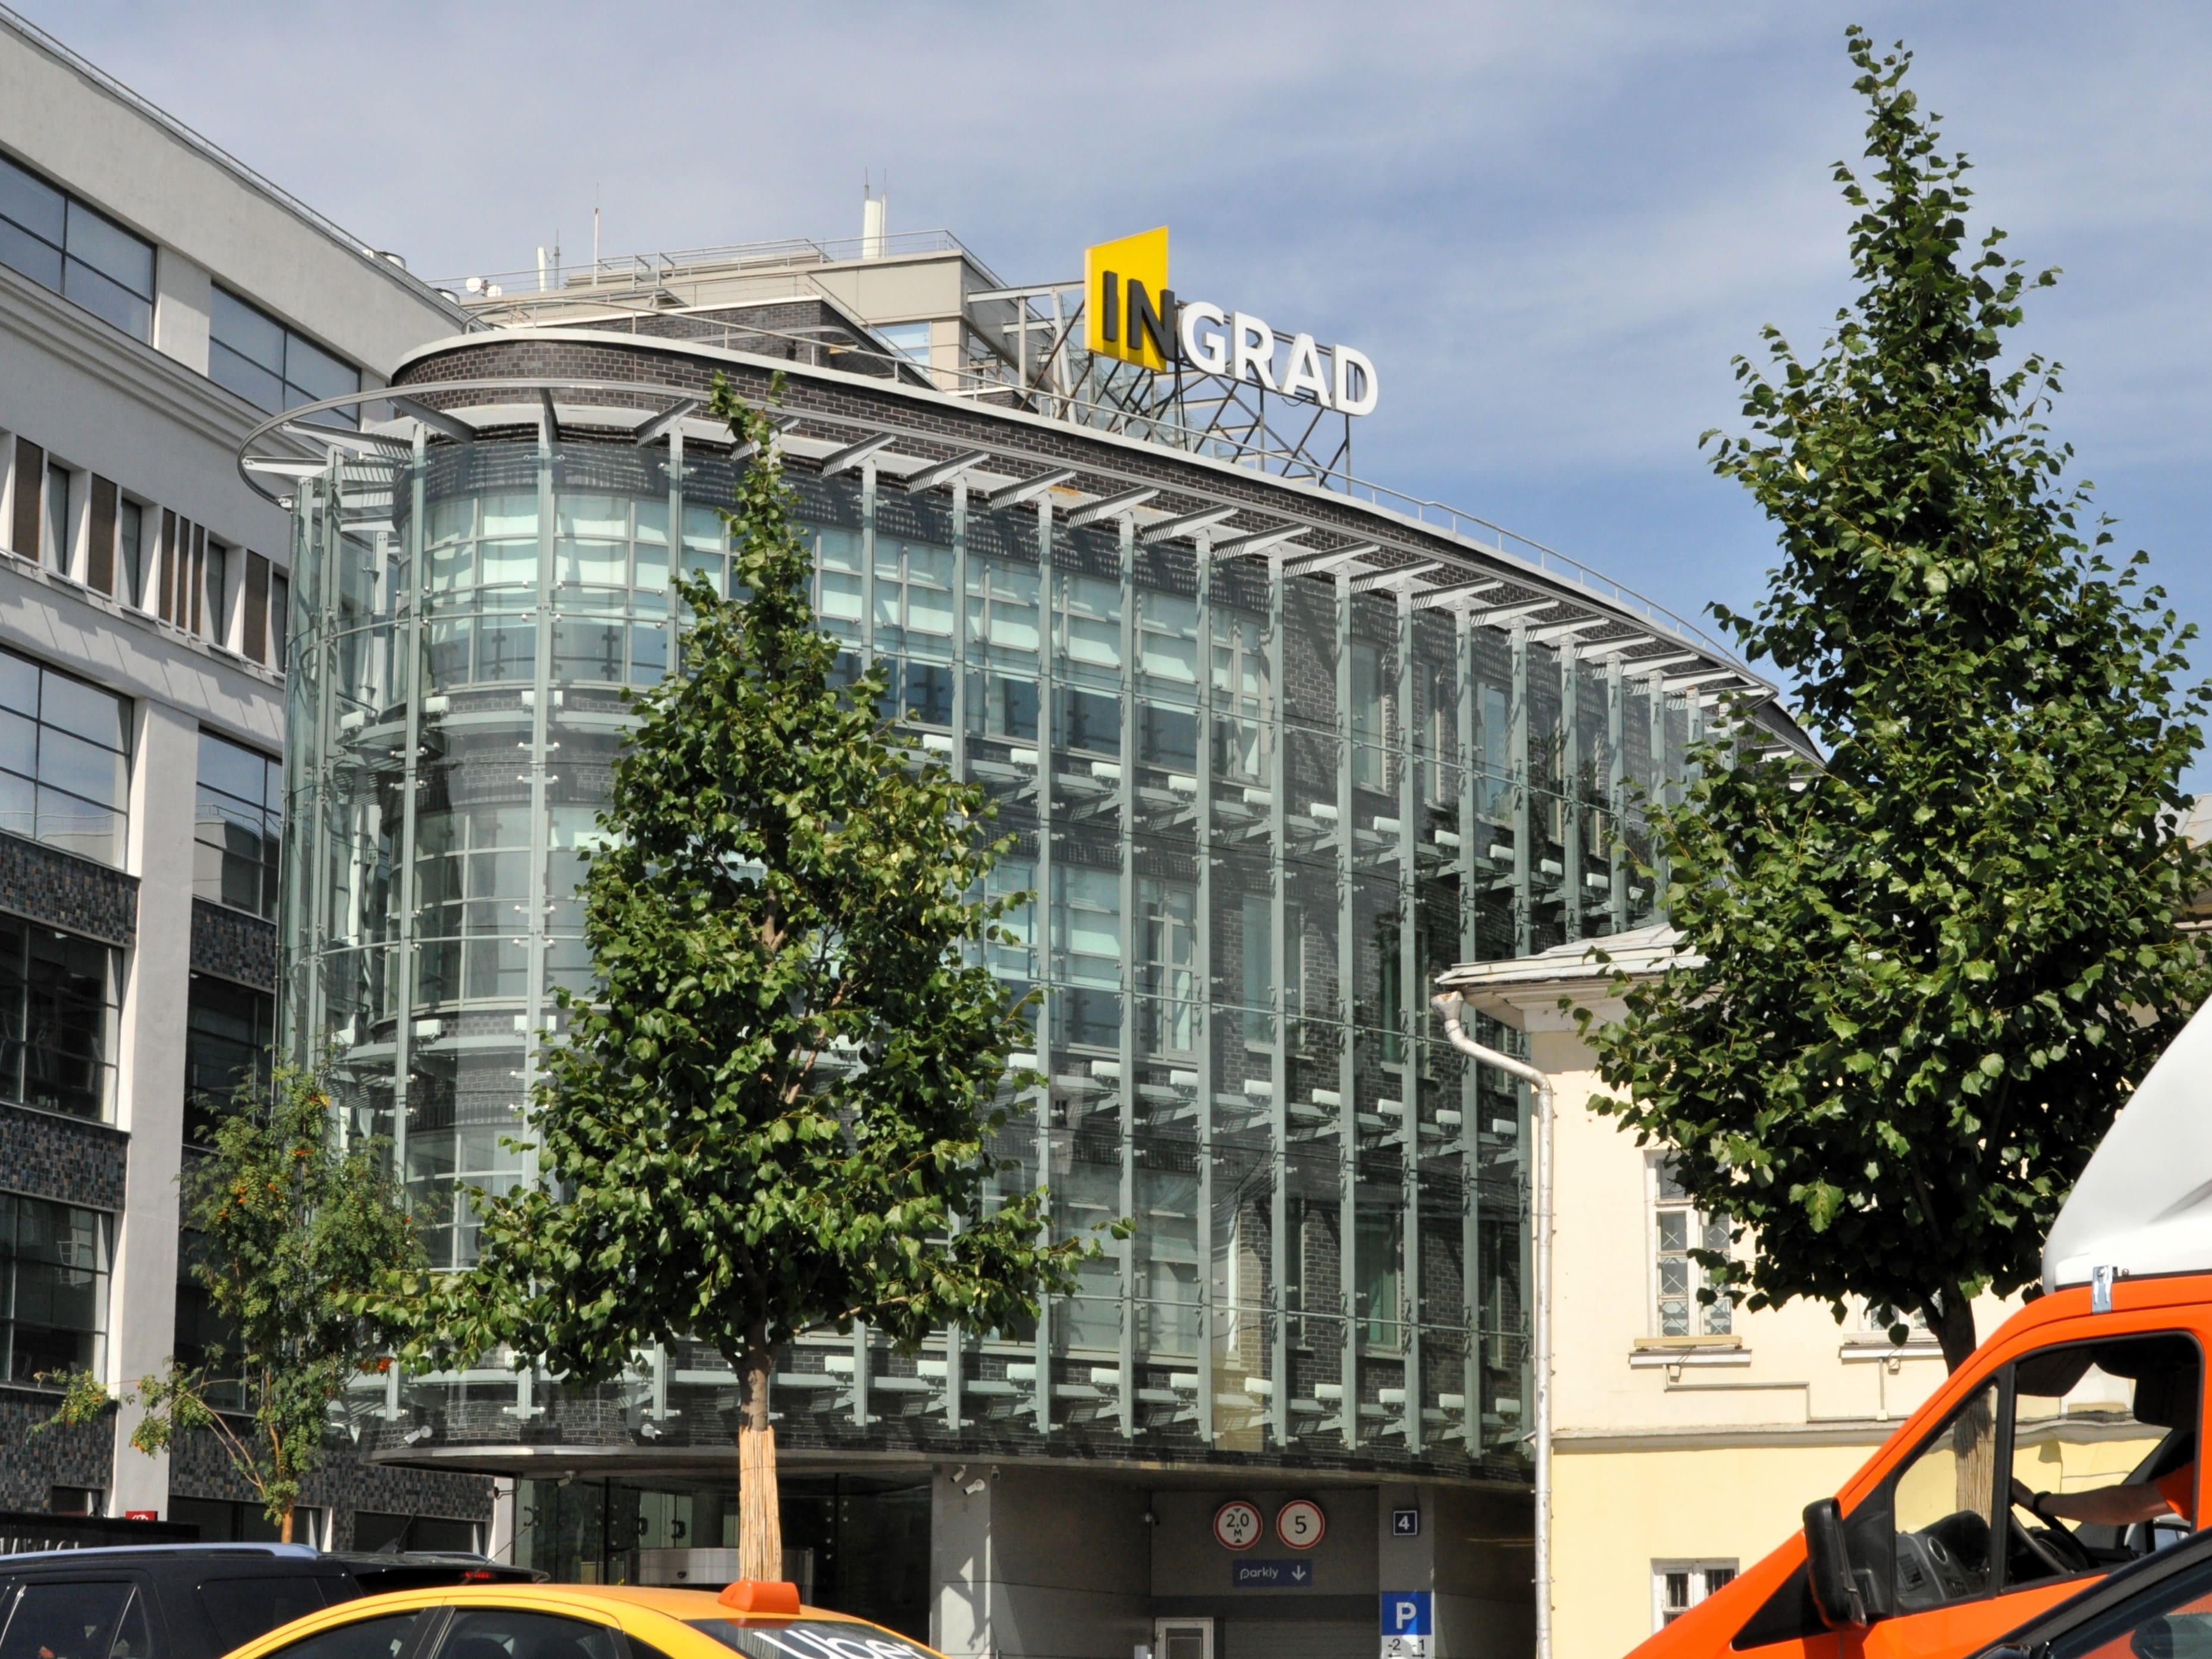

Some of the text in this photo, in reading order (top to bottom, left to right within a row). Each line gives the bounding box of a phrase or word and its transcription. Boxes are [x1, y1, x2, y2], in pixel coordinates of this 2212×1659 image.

[1102, 271, 1379, 416] INGRAD
[1295, 1516, 1307, 1534] 5
[1398, 1516, 1410, 1530] 4
[1240, 1567, 1278, 1580] parkly
[1396, 1602, 1417, 1629] P
[752, 1629, 928, 1659] Uber
[1388, 1639, 1425, 1651] -2 -1
